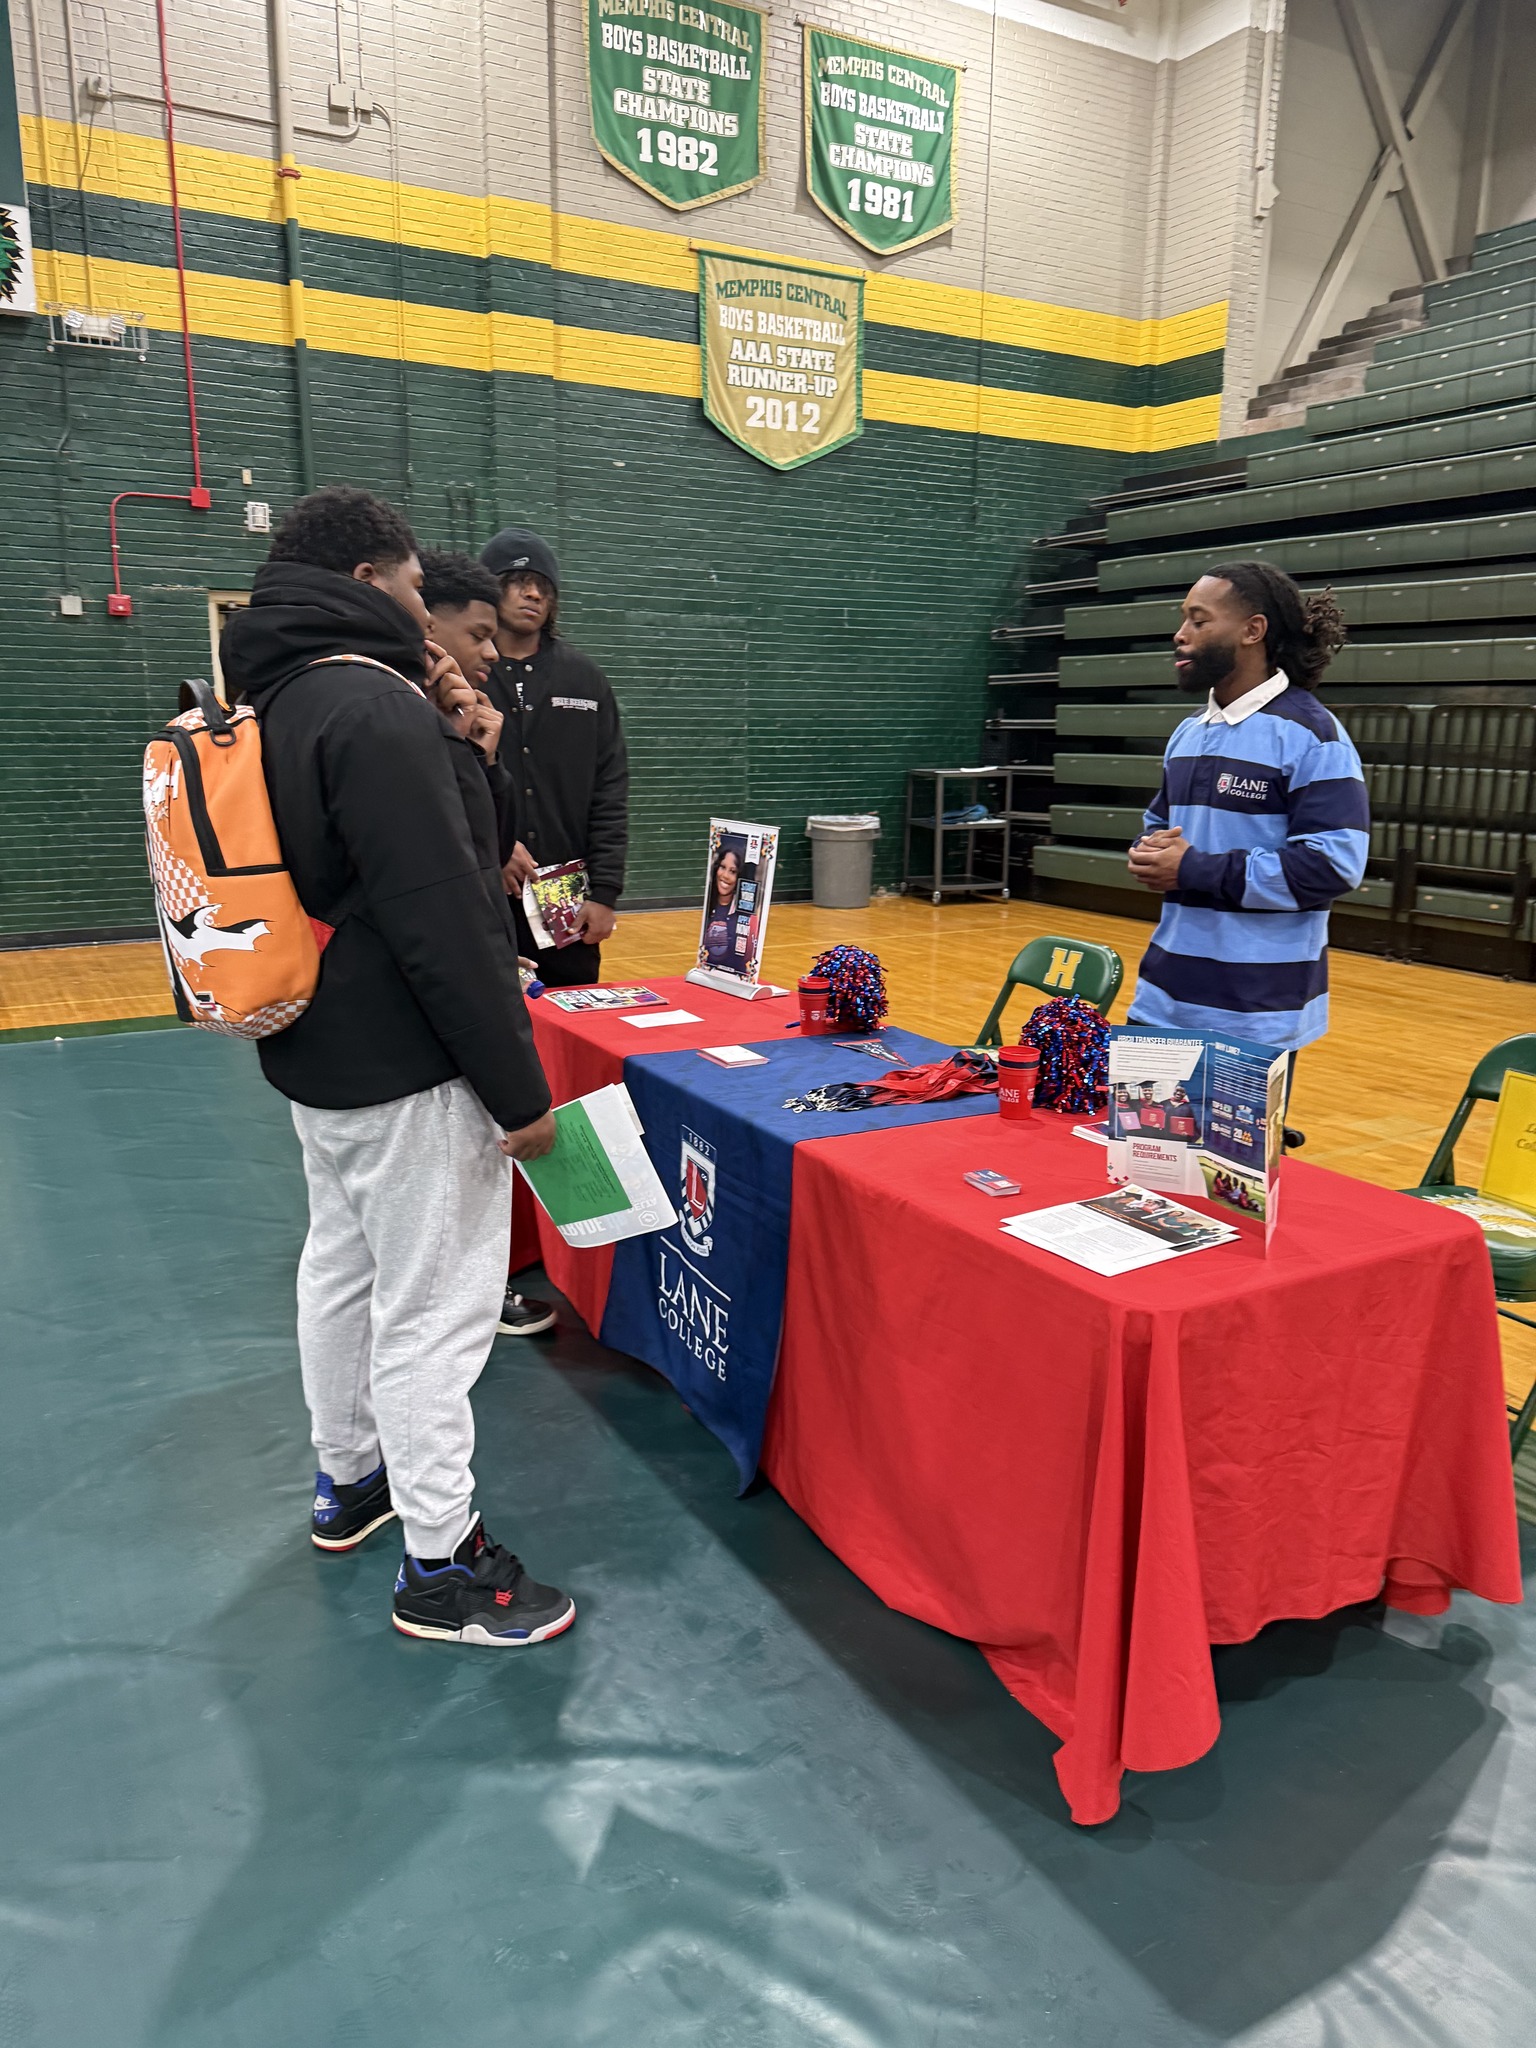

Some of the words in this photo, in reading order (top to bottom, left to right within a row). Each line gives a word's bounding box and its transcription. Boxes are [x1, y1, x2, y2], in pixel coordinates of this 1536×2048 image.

[598, 0, 676, 21] MEMPHIS
[679, 4, 753, 53] CENTRAL
[601, 22, 643, 56] BOYS
[646, 33, 751, 80] BASKETBALL
[643, 66, 711, 106] STATE
[818, 56, 884, 80] MEMPHIS
[888, 64, 950, 108] CENTRAL
[614, 88, 740, 137] CHAMPIONS
[820, 82, 856, 112] BOYS
[858, 92, 945, 134] BASKETBALL
[636, 127, 718, 176] 1982
[854, 122, 913, 158] STATE
[829, 142, 935, 187] CHAMPIONS
[847, 178, 914, 222] 1981
[715, 279, 782, 300] MEMPHIS
[786, 283, 847, 321] CENTRAL
[719, 304, 753, 332] BOYS
[757, 311, 846, 346] BASKETBALL
[730, 337, 773, 365] AAA
[776, 344, 836, 374] STATE
[726, 362, 838, 398] RUNNER-UP
[745, 395, 820, 434] 2012
[1230, 789, 1267, 800] COLLEGE
[1232, 776, 1269, 793] LANE
[1043, 947, 1084, 990] H
[1135, 1036, 1166, 1045] TRANSFER
[999, 1088, 1019, 1098] ANE
[688, 1132, 710, 1156] 1882
[1132, 1142, 1161, 1152] PROGRAM
[1132, 1150, 1178, 1162] REQUIREMENTS
[659, 1252, 729, 1354] LANE
[658, 1298, 727, 1382] COLLEGE
